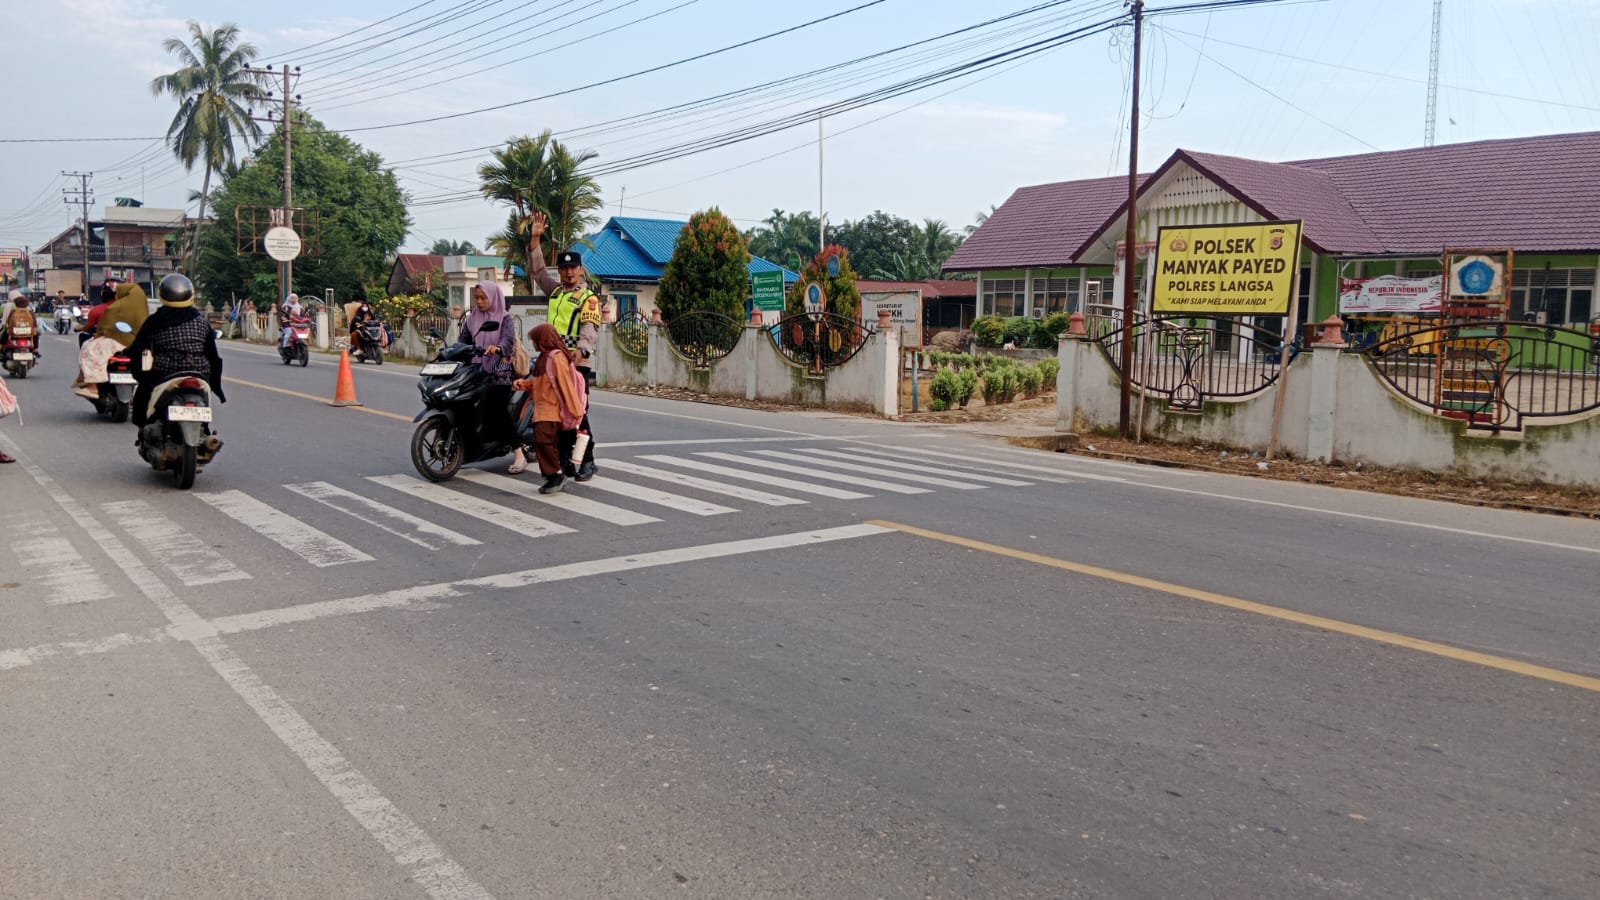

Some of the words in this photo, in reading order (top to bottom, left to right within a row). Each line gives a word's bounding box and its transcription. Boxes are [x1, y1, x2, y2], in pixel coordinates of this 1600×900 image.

[1194, 238, 1256, 254] POLSEK
[1162, 260, 1229, 274] MANYAK
[1232, 258, 1286, 274] PAYED
[1168, 281, 1216, 291] POLRES
[1220, 281, 1274, 291] LANGSA
[1207, 298, 1245, 306] MELAYANI
